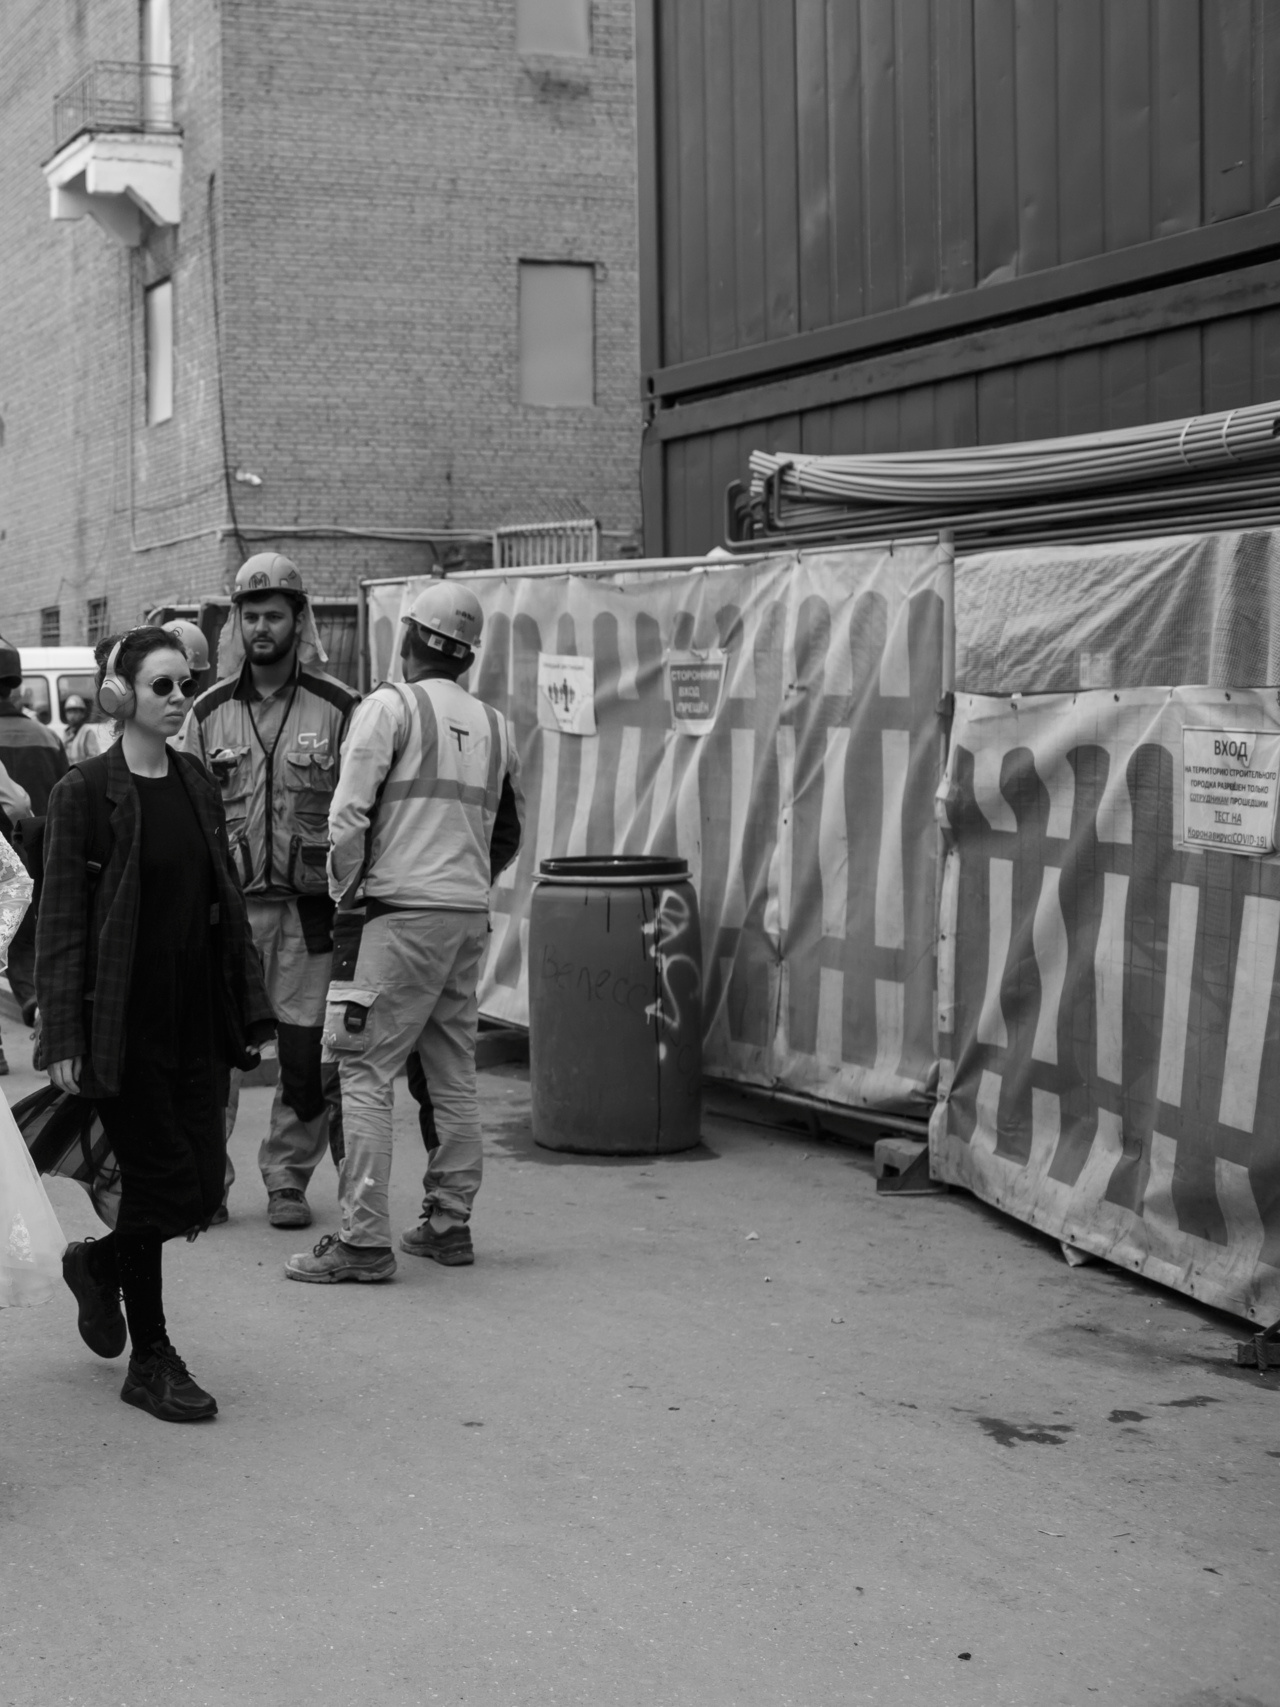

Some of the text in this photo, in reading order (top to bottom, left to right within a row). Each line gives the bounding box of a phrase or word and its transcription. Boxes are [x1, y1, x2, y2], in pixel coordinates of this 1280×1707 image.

[671, 670, 719, 681] СТОРОННИМ
[679, 686, 700, 697] ВХОД
[1214, 740, 1247, 761] ВХОД
[1192, 766, 1228, 776] ТЕРРИТОРИЮ
[1230, 769, 1276, 780] СТРОИТЕЛЬНОГО
[1191, 779, 1216, 789] ГОРОДКА
[1247, 784, 1269, 794] ТОЛЬКО
[1190, 793, 1268, 808] СОТРУДНИКАМ ПРОШЕДШИМ
[1214, 810, 1242, 824] ТЕСТ НА
